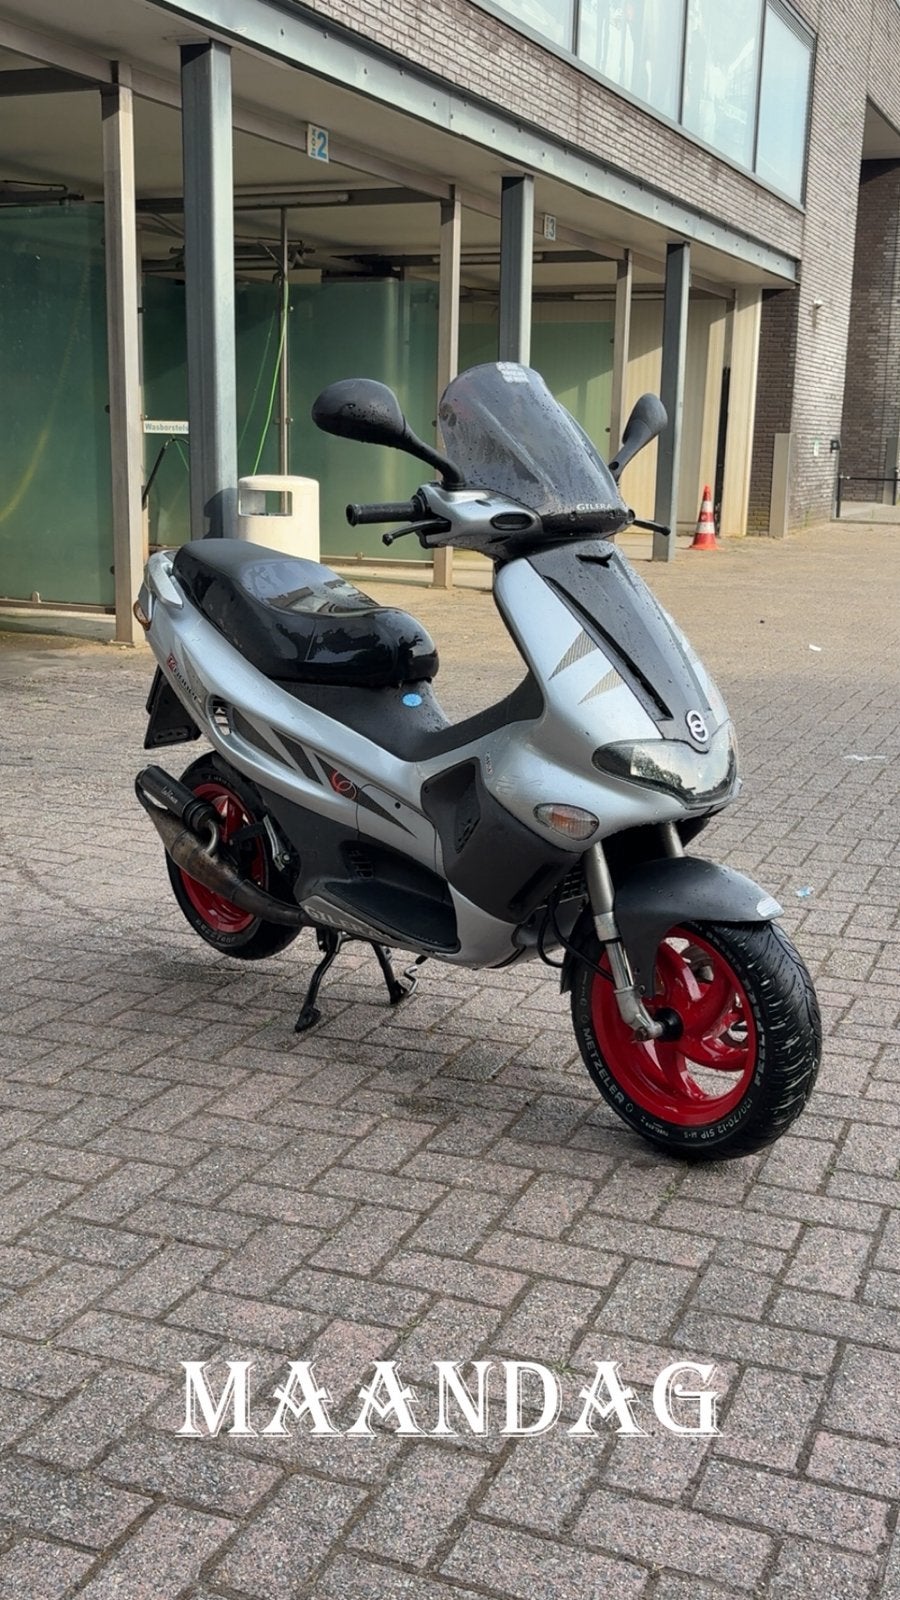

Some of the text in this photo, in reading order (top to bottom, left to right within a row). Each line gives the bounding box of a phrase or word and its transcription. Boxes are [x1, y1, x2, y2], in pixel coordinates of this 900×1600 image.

[316, 130, 328, 160] 2
[549, 218, 555, 238] 3
[576, 503, 615, 511] GILERA
[582, 1026, 625, 1105] METZELER
